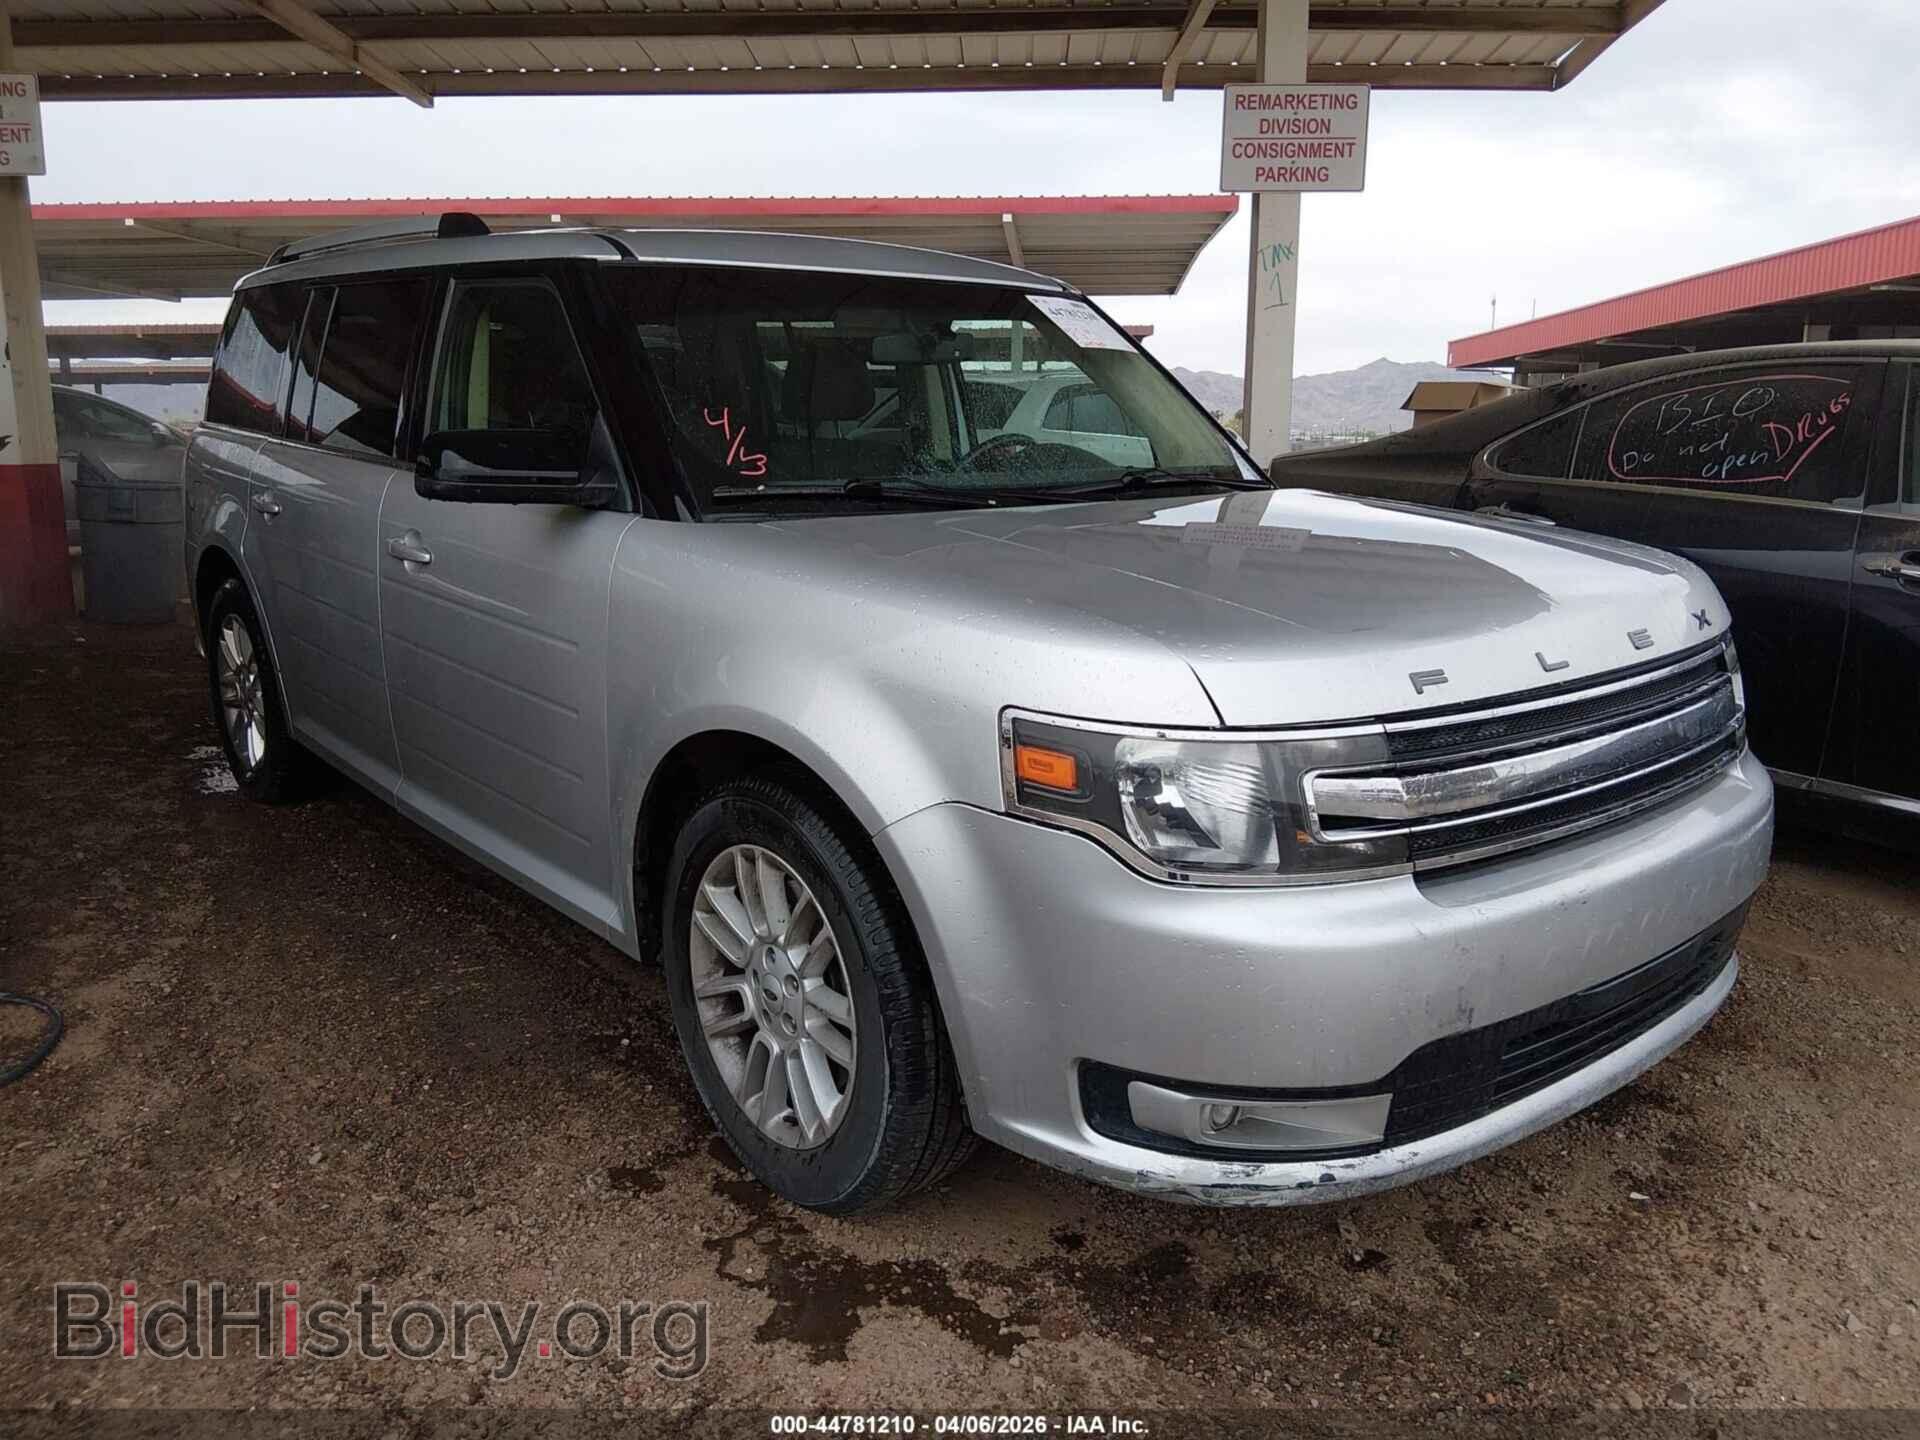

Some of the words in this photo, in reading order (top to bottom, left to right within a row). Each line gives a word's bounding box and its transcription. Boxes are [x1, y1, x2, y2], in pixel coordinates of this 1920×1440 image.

[1235, 94, 1358, 110] REMARKETING
[1259, 118, 1331, 134] DIVISION
[1232, 142, 1356, 159] CONSIGNMENT
[1255, 166, 1329, 182] PARKING
[1655, 386, 1777, 434] BIO
[1408, 608, 1712, 695] FLEX
